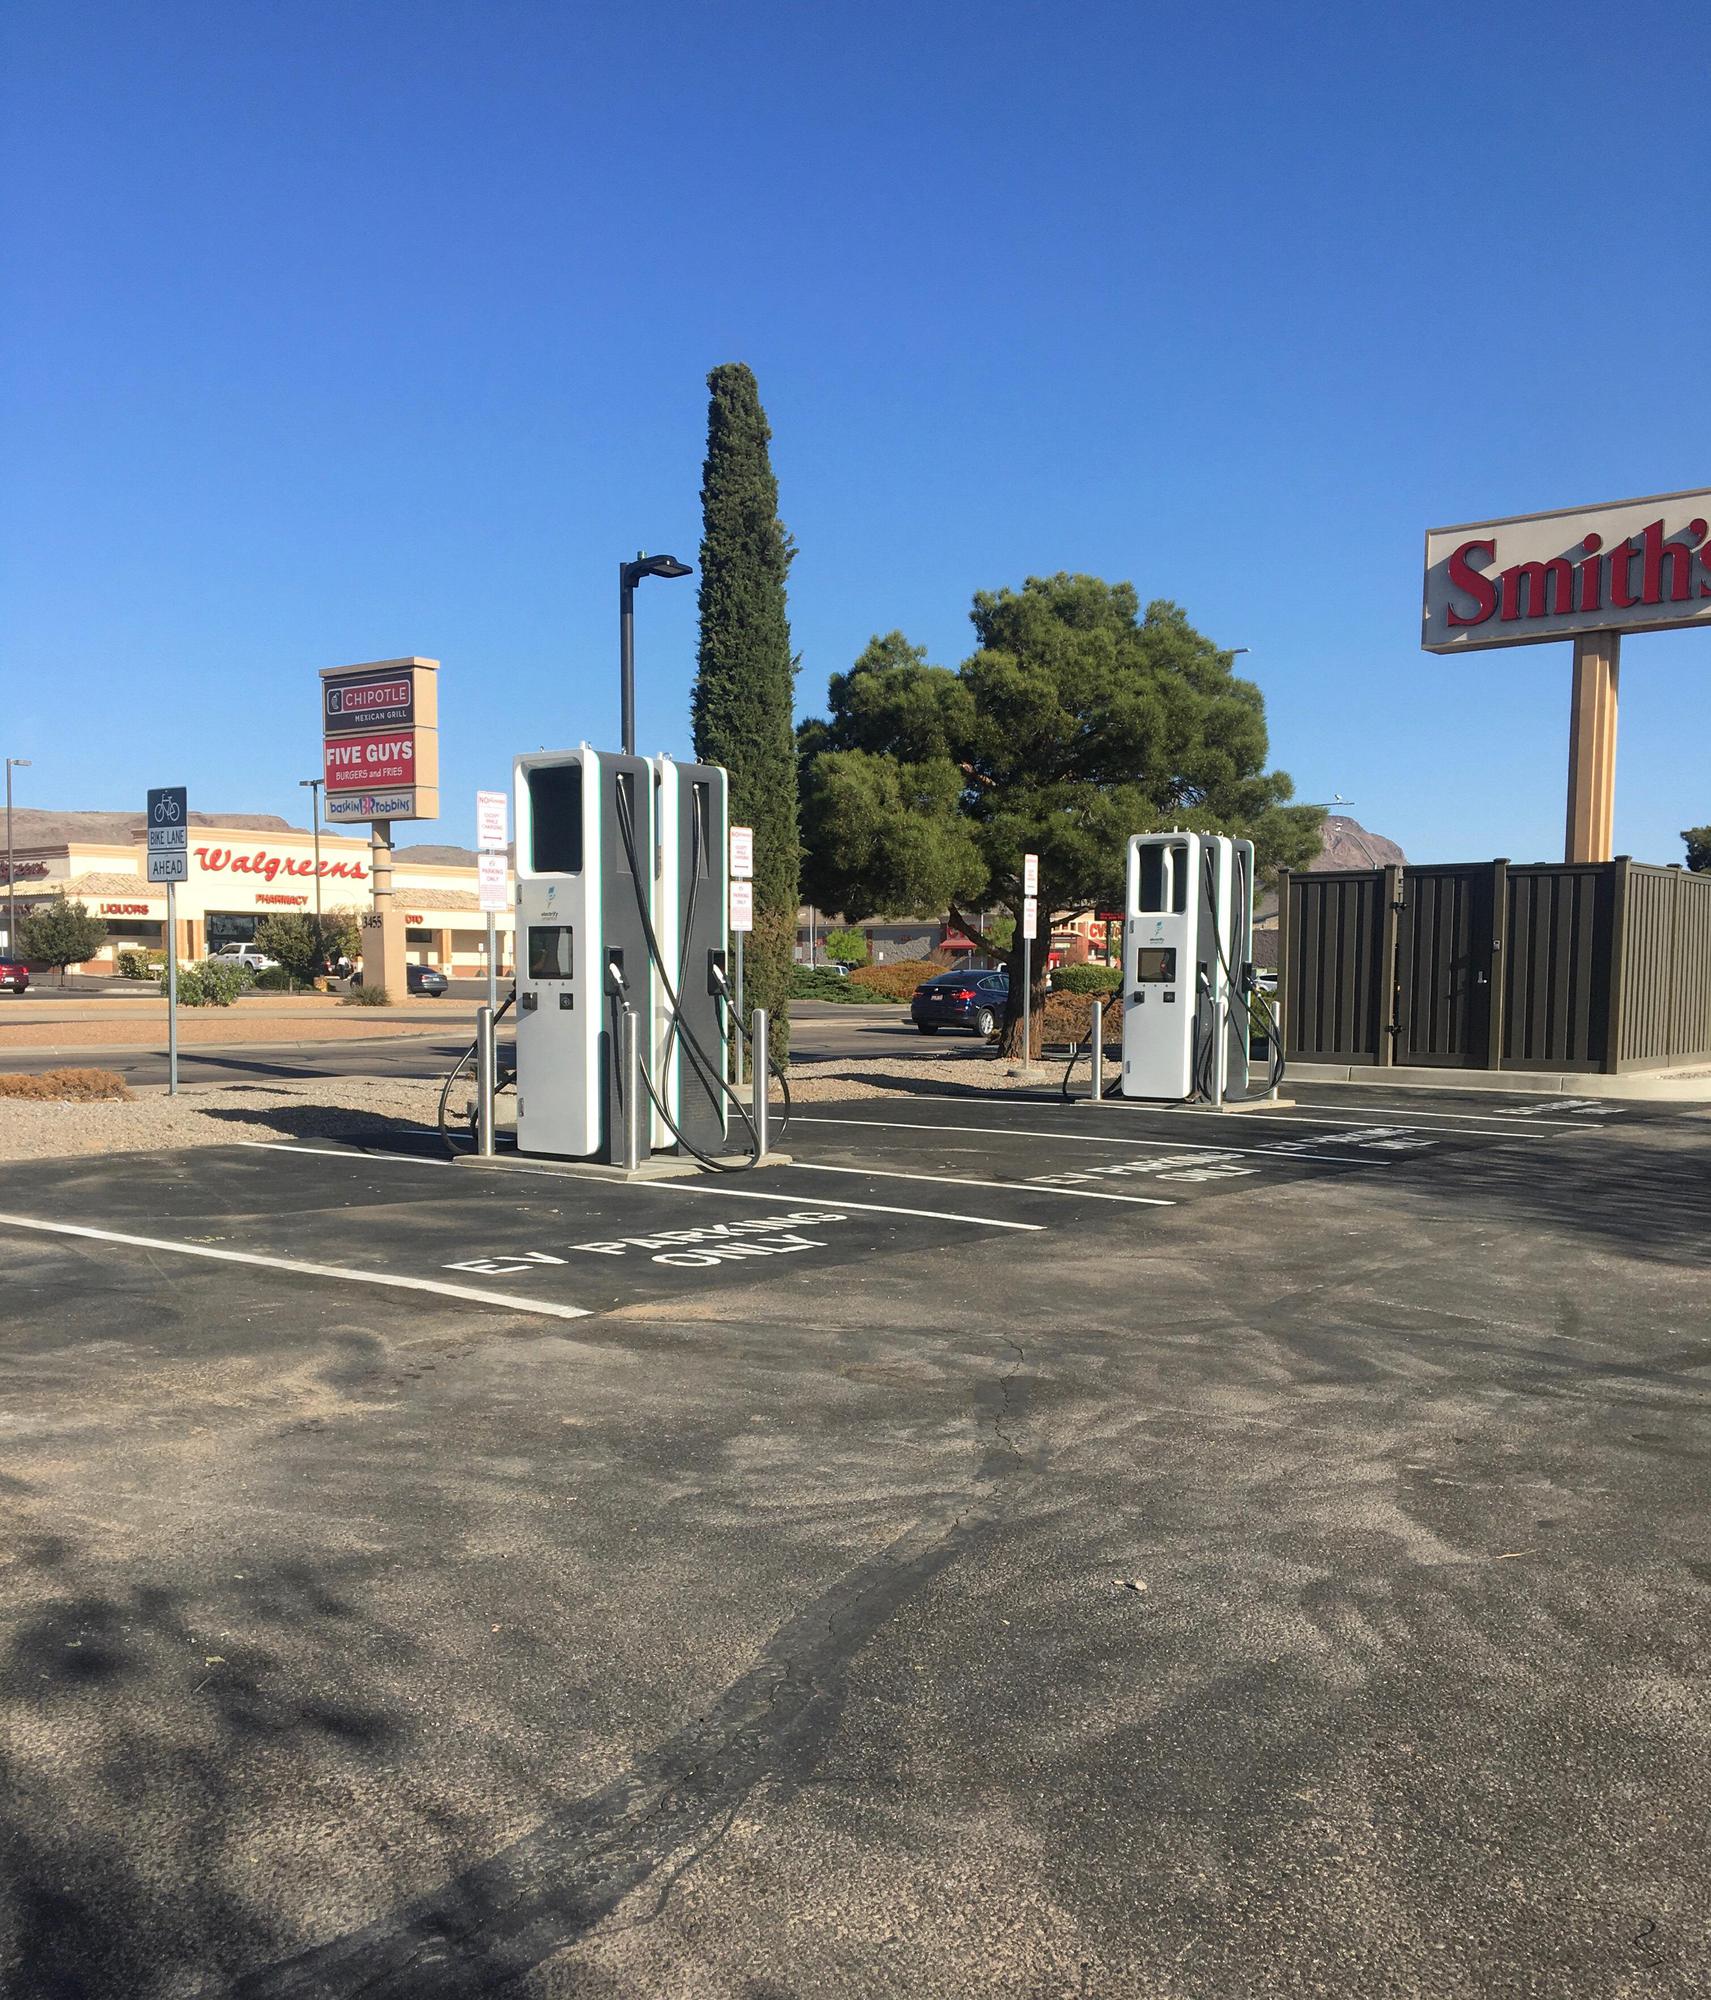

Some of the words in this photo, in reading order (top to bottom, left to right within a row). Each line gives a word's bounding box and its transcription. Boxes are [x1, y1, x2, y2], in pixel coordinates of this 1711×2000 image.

[345, 687, 407, 706] CHIPOTLE
[354, 712, 385, 722] MEXICAN
[387, 710, 407, 719] GRILL
[326, 746, 361, 766] FIVE
[366, 741, 413, 762] GUYS
[336, 769, 368, 780] BURGERS
[369, 769, 381, 778] and
[383, 767, 403, 776] FRIES
[330, 802, 360, 813] baskin
[375, 800, 410, 812] robbins
[150, 831, 165, 846] BIKE
[166, 830, 184, 845] LANE
[152, 860, 183, 874] AHEAD
[194, 848, 368, 881] Walgreens
[255, 893, 308, 905] PHARMACY
[100, 903, 149, 915] LIQUORS
[363, 915, 382, 928] 3455
[405, 914, 424, 924] OTO
[441, 1251, 569, 1275] EV
[568, 1212, 847, 1255] PARKING
[651, 1234, 829, 1267] ONLY
